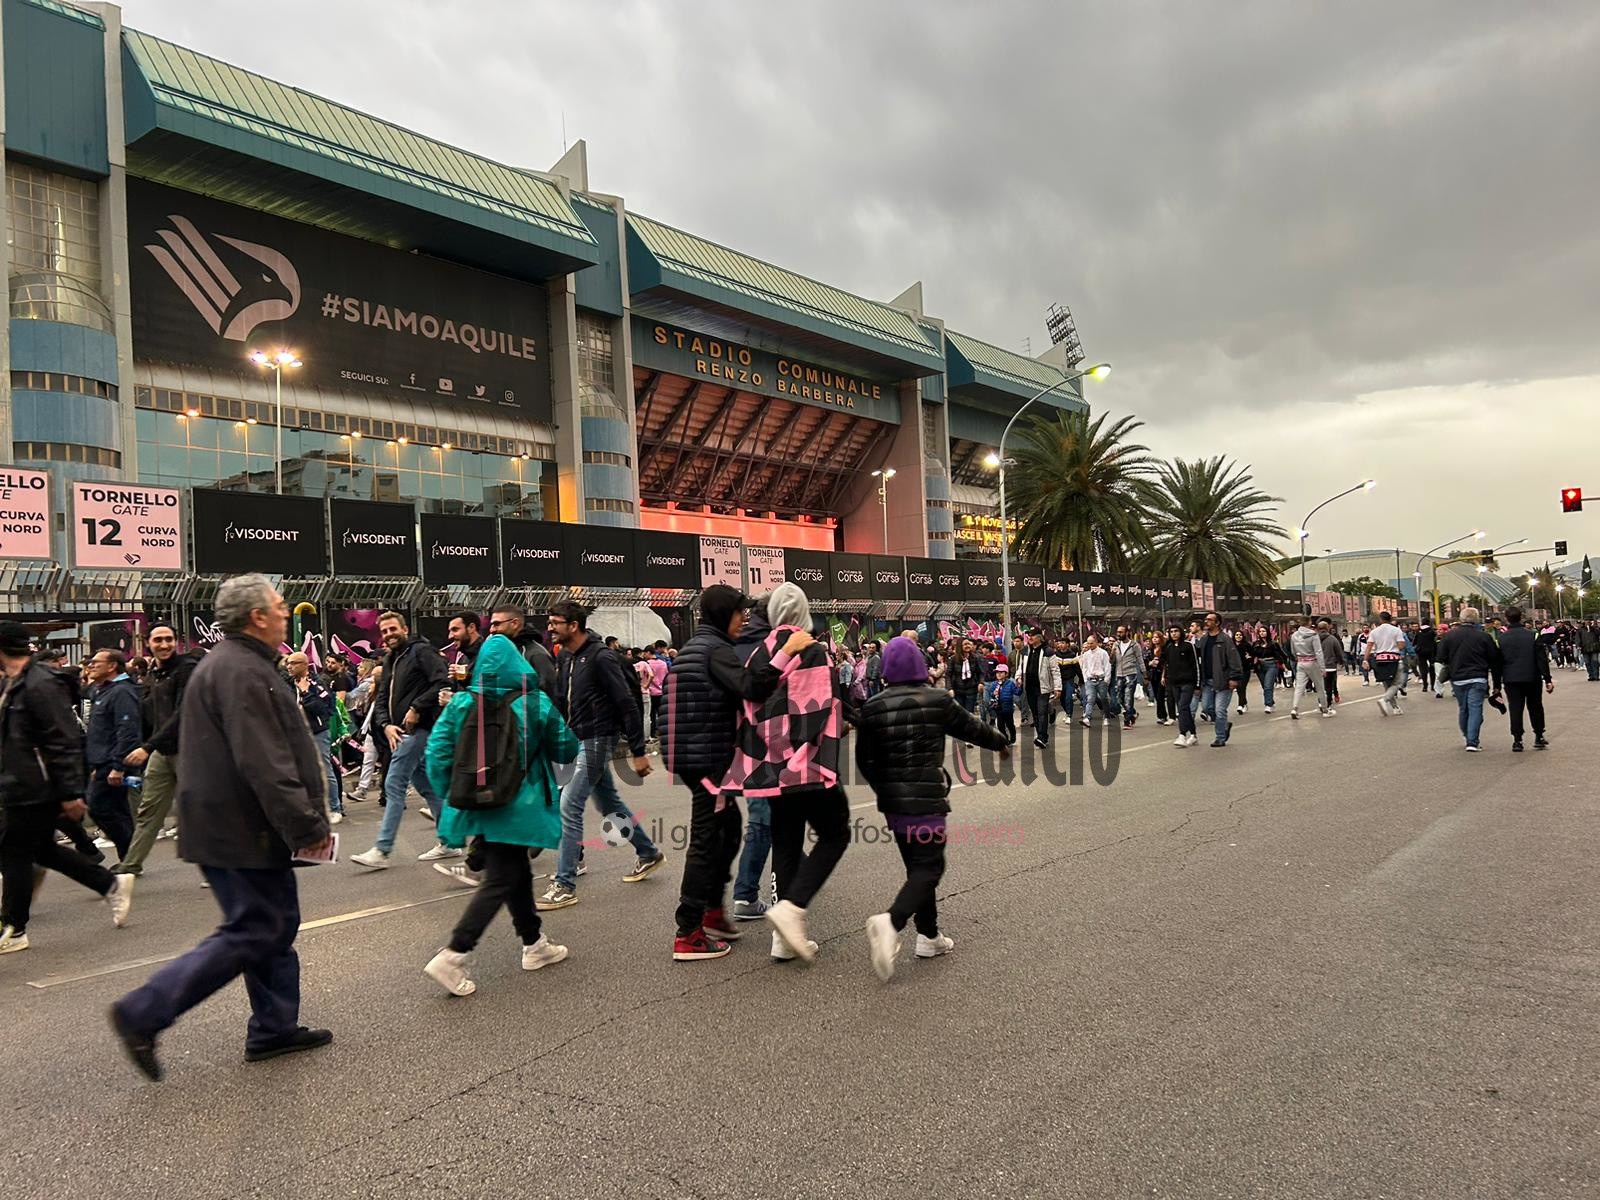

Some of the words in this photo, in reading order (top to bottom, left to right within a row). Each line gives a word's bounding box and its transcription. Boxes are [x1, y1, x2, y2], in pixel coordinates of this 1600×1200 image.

[322, 293, 536, 361] #SIAMOAQUILE
[654, 326, 752, 366] STADIO
[777, 360, 881, 400] COMUNALE
[341, 370, 374, 383] SEGUICI
[375, 376, 389, 385] SU:
[696, 360, 763, 386] RENZO
[777, 379, 855, 408] BARBERA
[80, 488, 178, 507] TORNELLO
[0, 510, 45, 522] CURVA
[112, 504, 149, 517] GATE
[3, 524, 42, 534] NORD
[82, 517, 122, 547] 12
[138, 526, 177, 536] CURVA
[235, 527, 300, 541] VISODENT
[141, 538, 175, 548] NORD
[351, 533, 406, 545] VISODENT
[701, 538, 740, 549] TORNELLO
[439, 545, 489, 557] VISODENT
[517, 549, 560, 559] VISODENT
[714, 547, 728, 555] GATE
[748, 548, 783, 559] TORNELLO
[586, 553, 625, 563] VISODENT
[651, 556, 686, 566] VISODENT
[760, 557, 773, 565] GATE
[702, 558, 715, 576] 11
[768, 569, 784, 577] CURVA
[750, 567, 761, 585] 11
